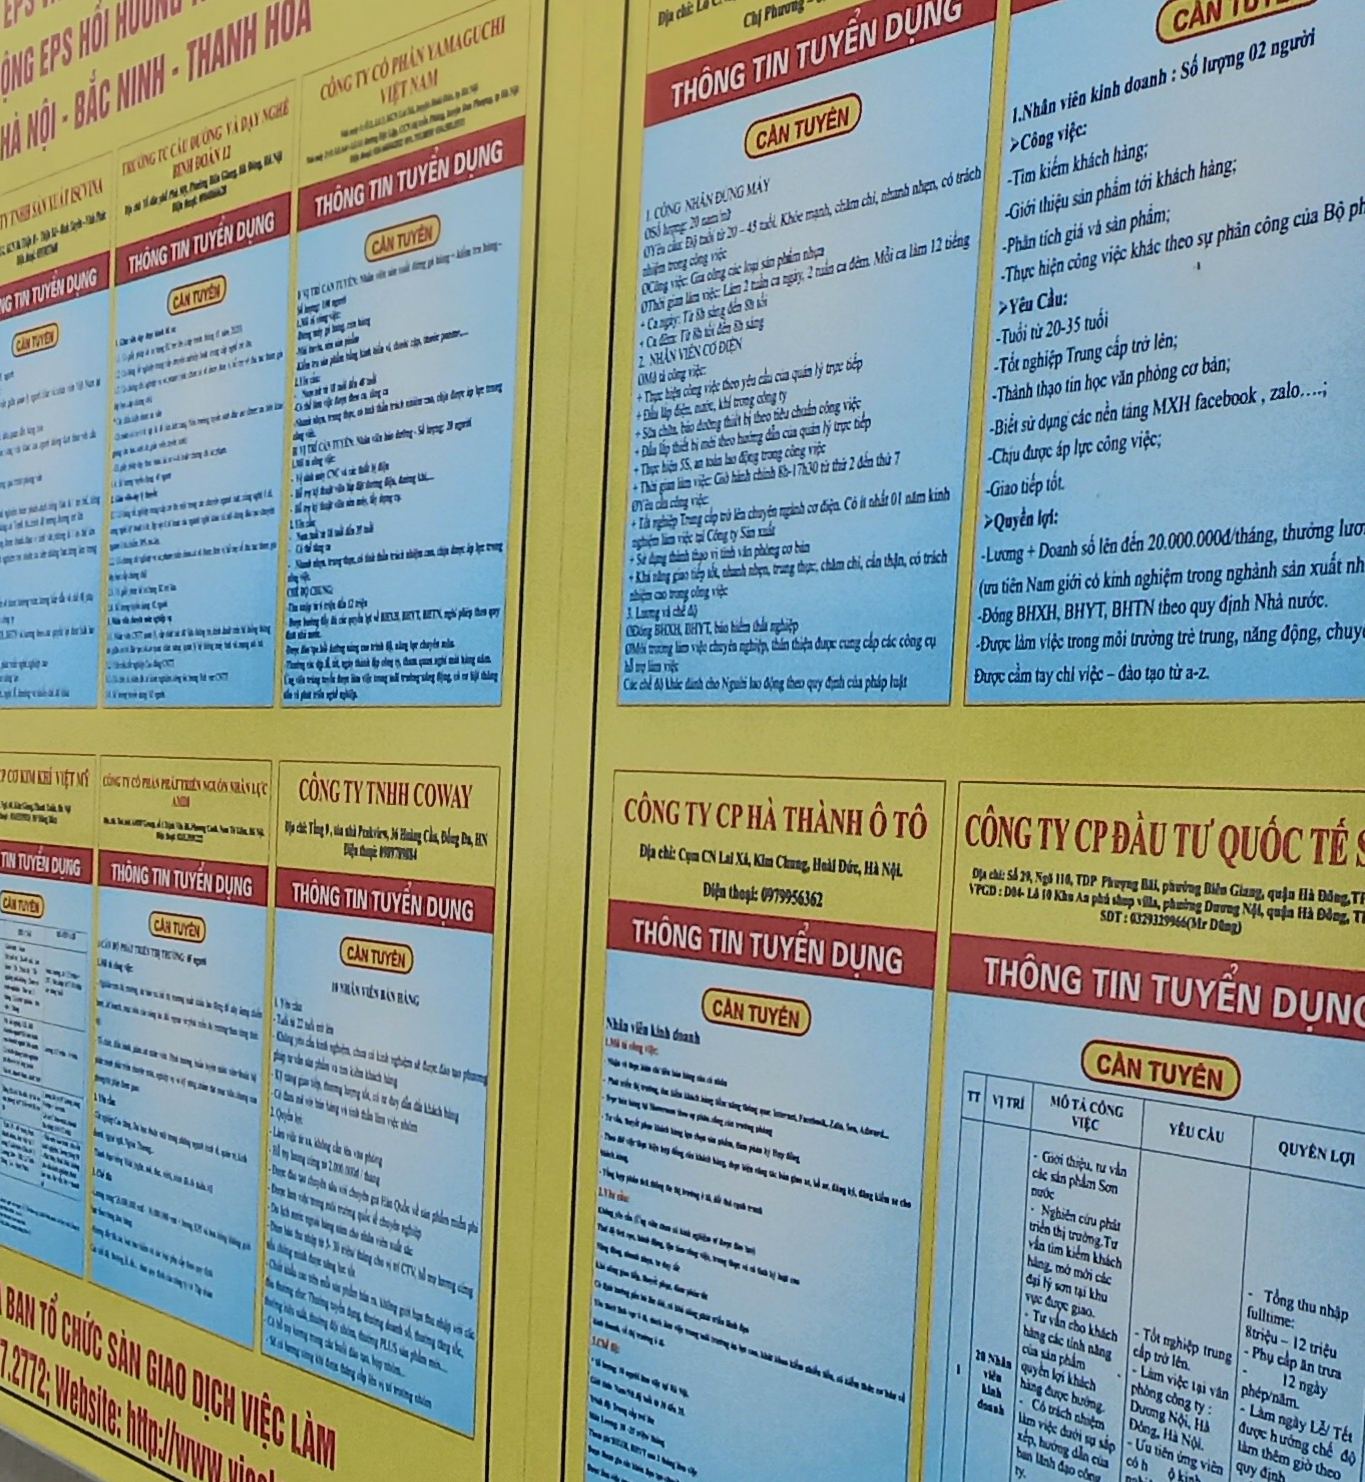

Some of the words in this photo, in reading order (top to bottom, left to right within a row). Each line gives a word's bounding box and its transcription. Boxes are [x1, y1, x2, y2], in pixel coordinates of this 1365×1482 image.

[40, 26, 72, 77] EPS
[320, 73, 353, 101] CÔNG
[355, 67, 370, 89] TY
[428, 15, 506, 60] YAMAGUCHI
[671, 67, 745, 108] THÔNG
[752, 49, 789, 85] TIN
[795, 7, 877, 69] TUYỂN
[884, 0, 963, 47] DỤNG
[1012, 99, 1057, 124] 1.Nhân
[1060, 90, 1087, 112] viên
[1091, 79, 1121, 104] kinh
[1124, 67, 1167, 95] doanh
[1180, 54, 1199, 81] Số
[1202, 51, 1245, 75] lượng
[1248, 41, 1267, 63] 02
[1270, 27, 1315, 59] người
[0, 112, 21, 161] HÀ
[27, 98, 56, 151] NỘI
[75, 69, 110, 130] BẮC
[117, 53, 165, 112] NINH
[187, 11, 258, 82] THANH
[380, 80, 408, 106] VIỆT
[410, 69, 438, 96] NAM
[1020, 130, 1054, 151] Công
[1057, 121, 1087, 142] việc:
[299, 771, 341, 803] CÔNG
[343, 780, 363, 804] TY
[366, 781, 409, 806] TNHH
[413, 783, 472, 809] COWAY
[624, 790, 679, 826] CÔNG
[685, 801, 712, 827] TY
[716, 802, 744, 828] CP
[747, 797, 777, 831] HÀ
[783, 799, 863, 837] THÀNH
[869, 801, 887, 837] Ô
[893, 802, 928, 839] TÔ
[965, 804, 1032, 850] CÔNG
[1038, 817, 1069, 852] TY
[1074, 819, 1108, 853] CP
[1111, 811, 1168, 857] ĐẦU
[1174, 819, 1216, 859] TƯ
[1218, 815, 1303, 869] QUỐC
[1310, 817, 1348, 867] TẾ
[292, 880, 341, 907] THÔNG
[344, 888, 368, 910] TIN
[372, 882, 422, 916] TUYỂN
[427, 897, 474, 926] DỤNG
[632, 916, 702, 950] THÔNG
[708, 927, 743, 955] TIN
[749, 922, 824, 965] TUYỂN
[832, 941, 903, 979] DỤNG
[967, 1091, 981, 1103] TT
[1007, 1096, 1025, 1111] TRÍ
[6, 1286, 35, 1330] BAN
[40, 1292, 58, 1340] TỔ
[62, 1310, 102, 1361] CHỨC
[107, 1329, 140, 1381] SÀN
[147, 1349, 186, 1401] GIAO
[192, 1369, 235, 1424] DỊCH
[242, 1392, 284, 1449] VIỆC
[291, 1410, 336, 1471] LÀM
[55, 1364, 121, 1438] Website:
